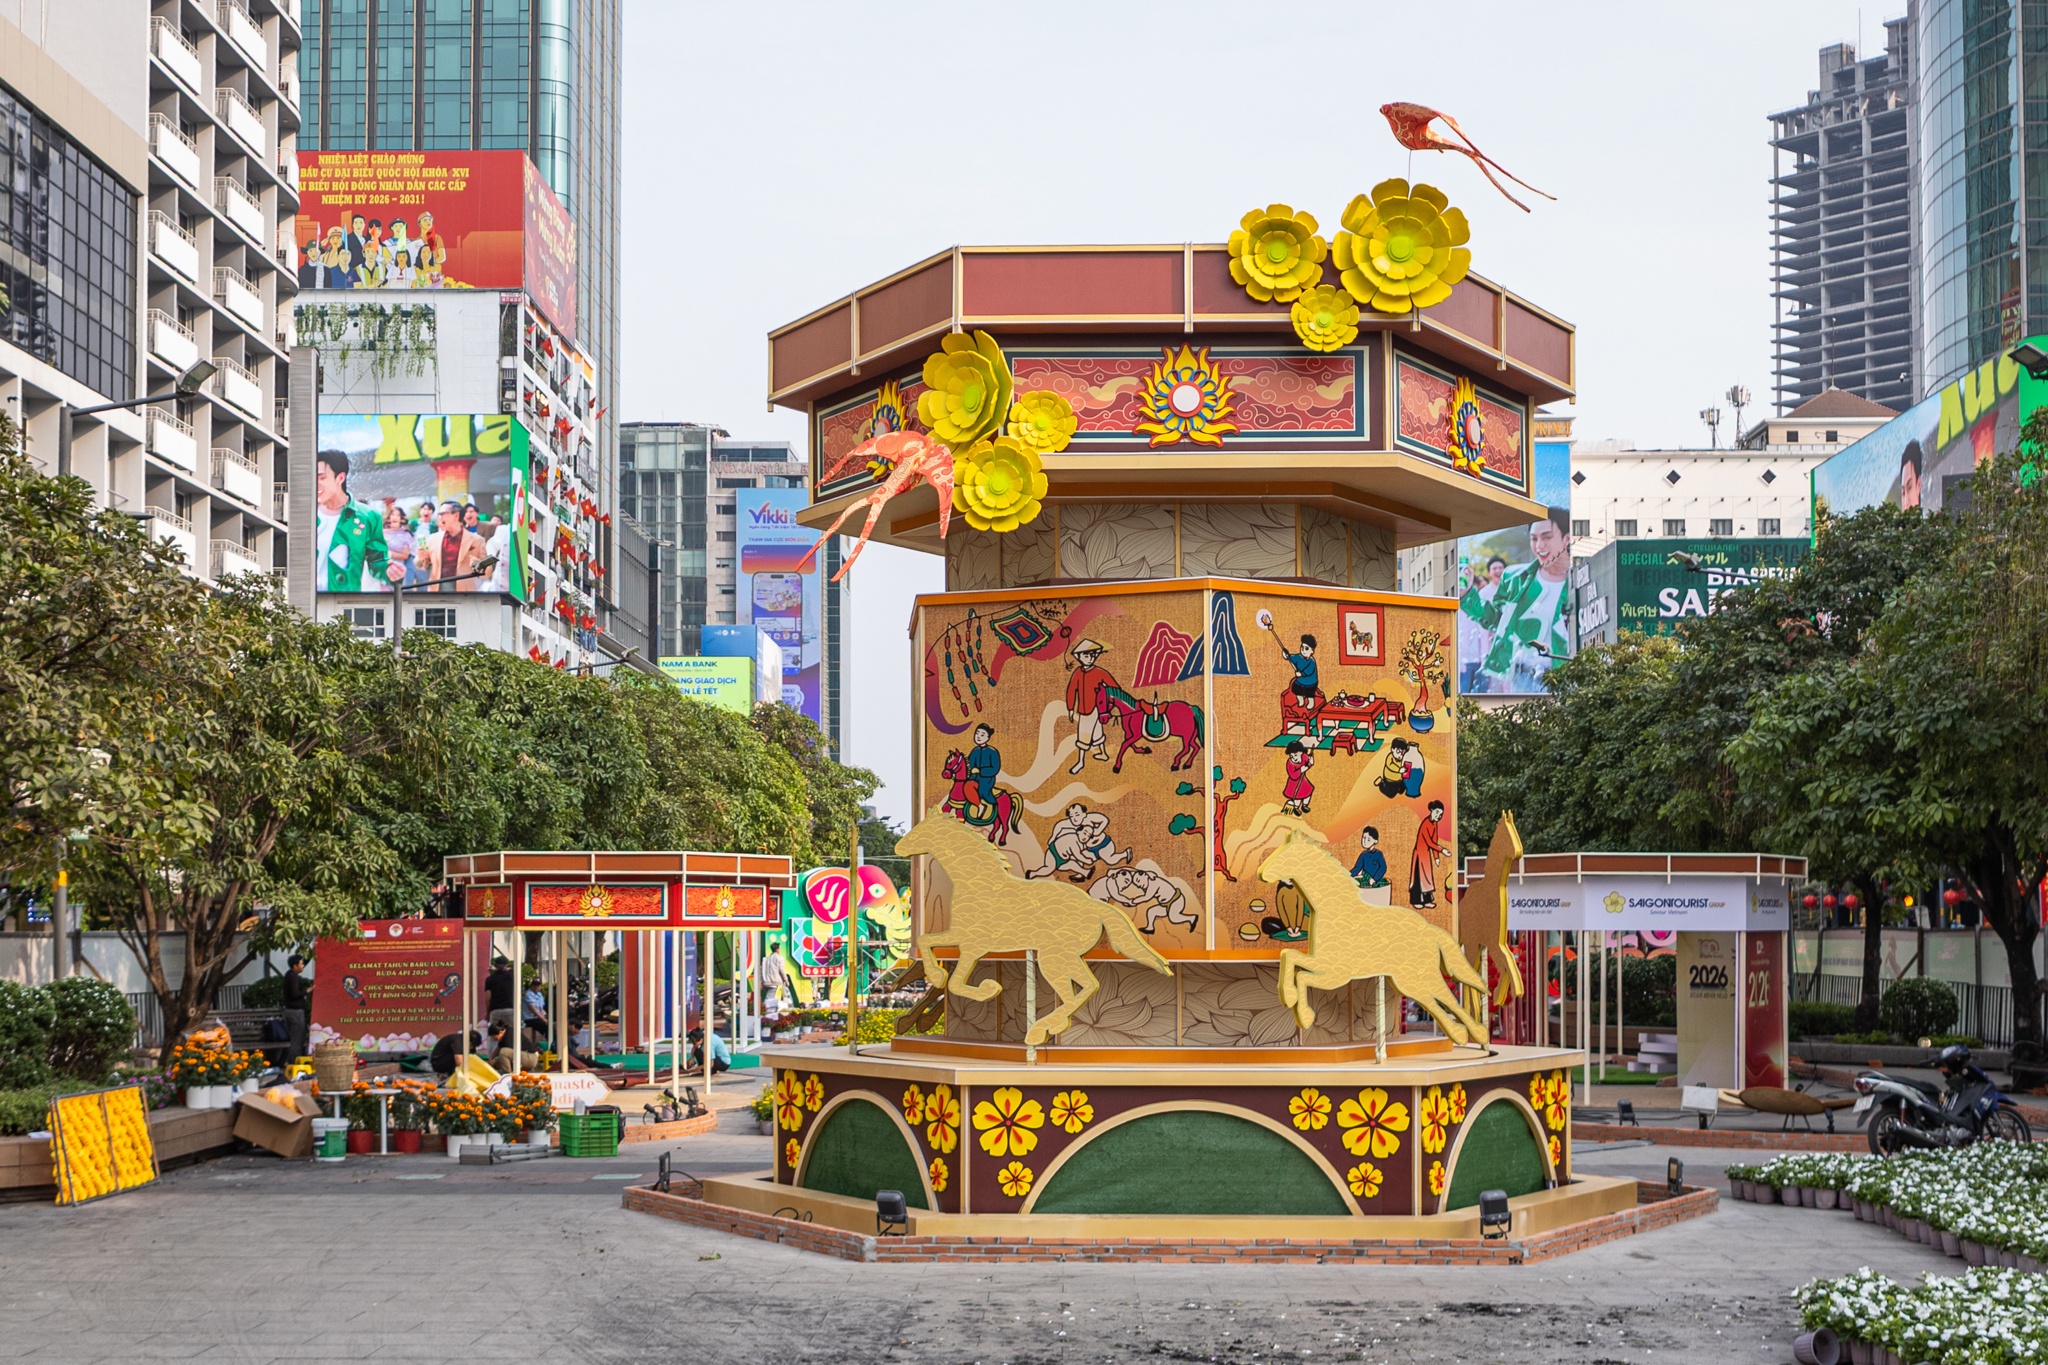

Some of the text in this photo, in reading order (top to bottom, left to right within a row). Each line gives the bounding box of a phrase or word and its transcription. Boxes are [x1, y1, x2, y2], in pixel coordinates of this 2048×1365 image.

[318, 152, 425, 166] NHIỆT LIỆT CHÀO MỪNG
[422, 166, 448, 177] KHÓA
[452, 168, 469, 177] XVI
[369, 194, 390, 204] 2026
[748, 502, 788, 524] Vikki
[1621, 551, 1664, 565] SPÉCIAL
[1707, 568, 1750, 586] BIA
[1621, 602, 1657, 617] พิเศษ
[1511, 898, 1560, 908] SAIGONTOURIST
[1628, 898, 1709, 908] SAIGONTOURIST
[1690, 965, 1728, 988] 2026
